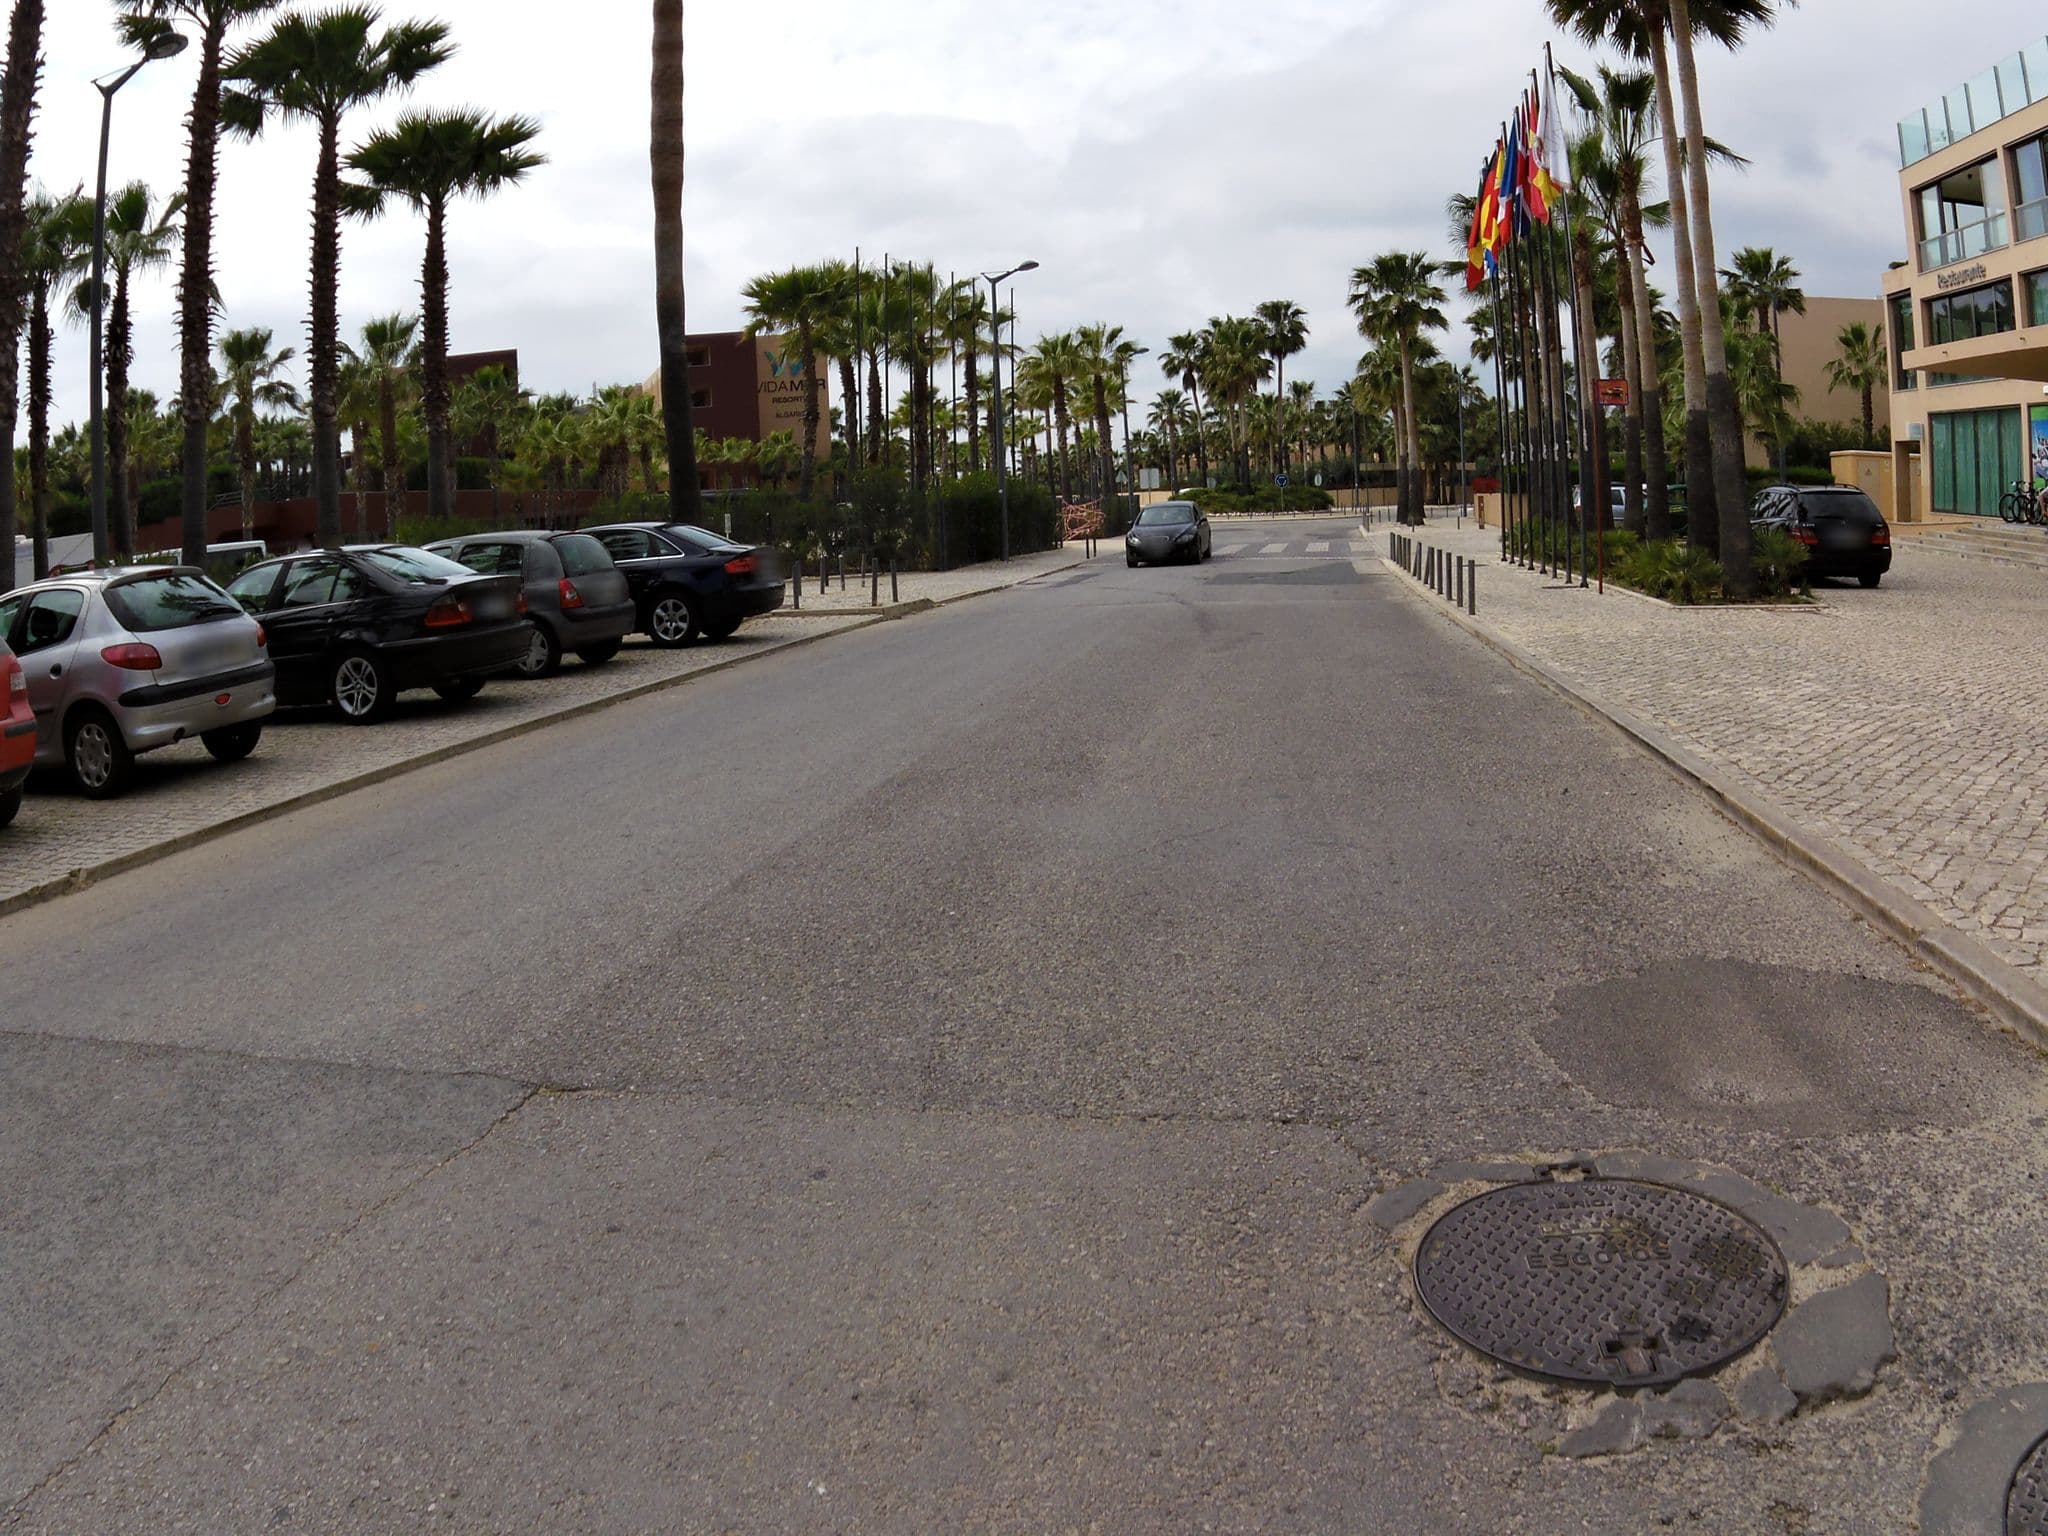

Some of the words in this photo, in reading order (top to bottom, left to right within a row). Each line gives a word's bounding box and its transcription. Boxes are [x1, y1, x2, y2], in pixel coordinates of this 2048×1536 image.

[1936, 262, 1987, 289] Restaurante
[756, 379, 826, 393] VIDAMR
[772, 395, 808, 404] RESORT
